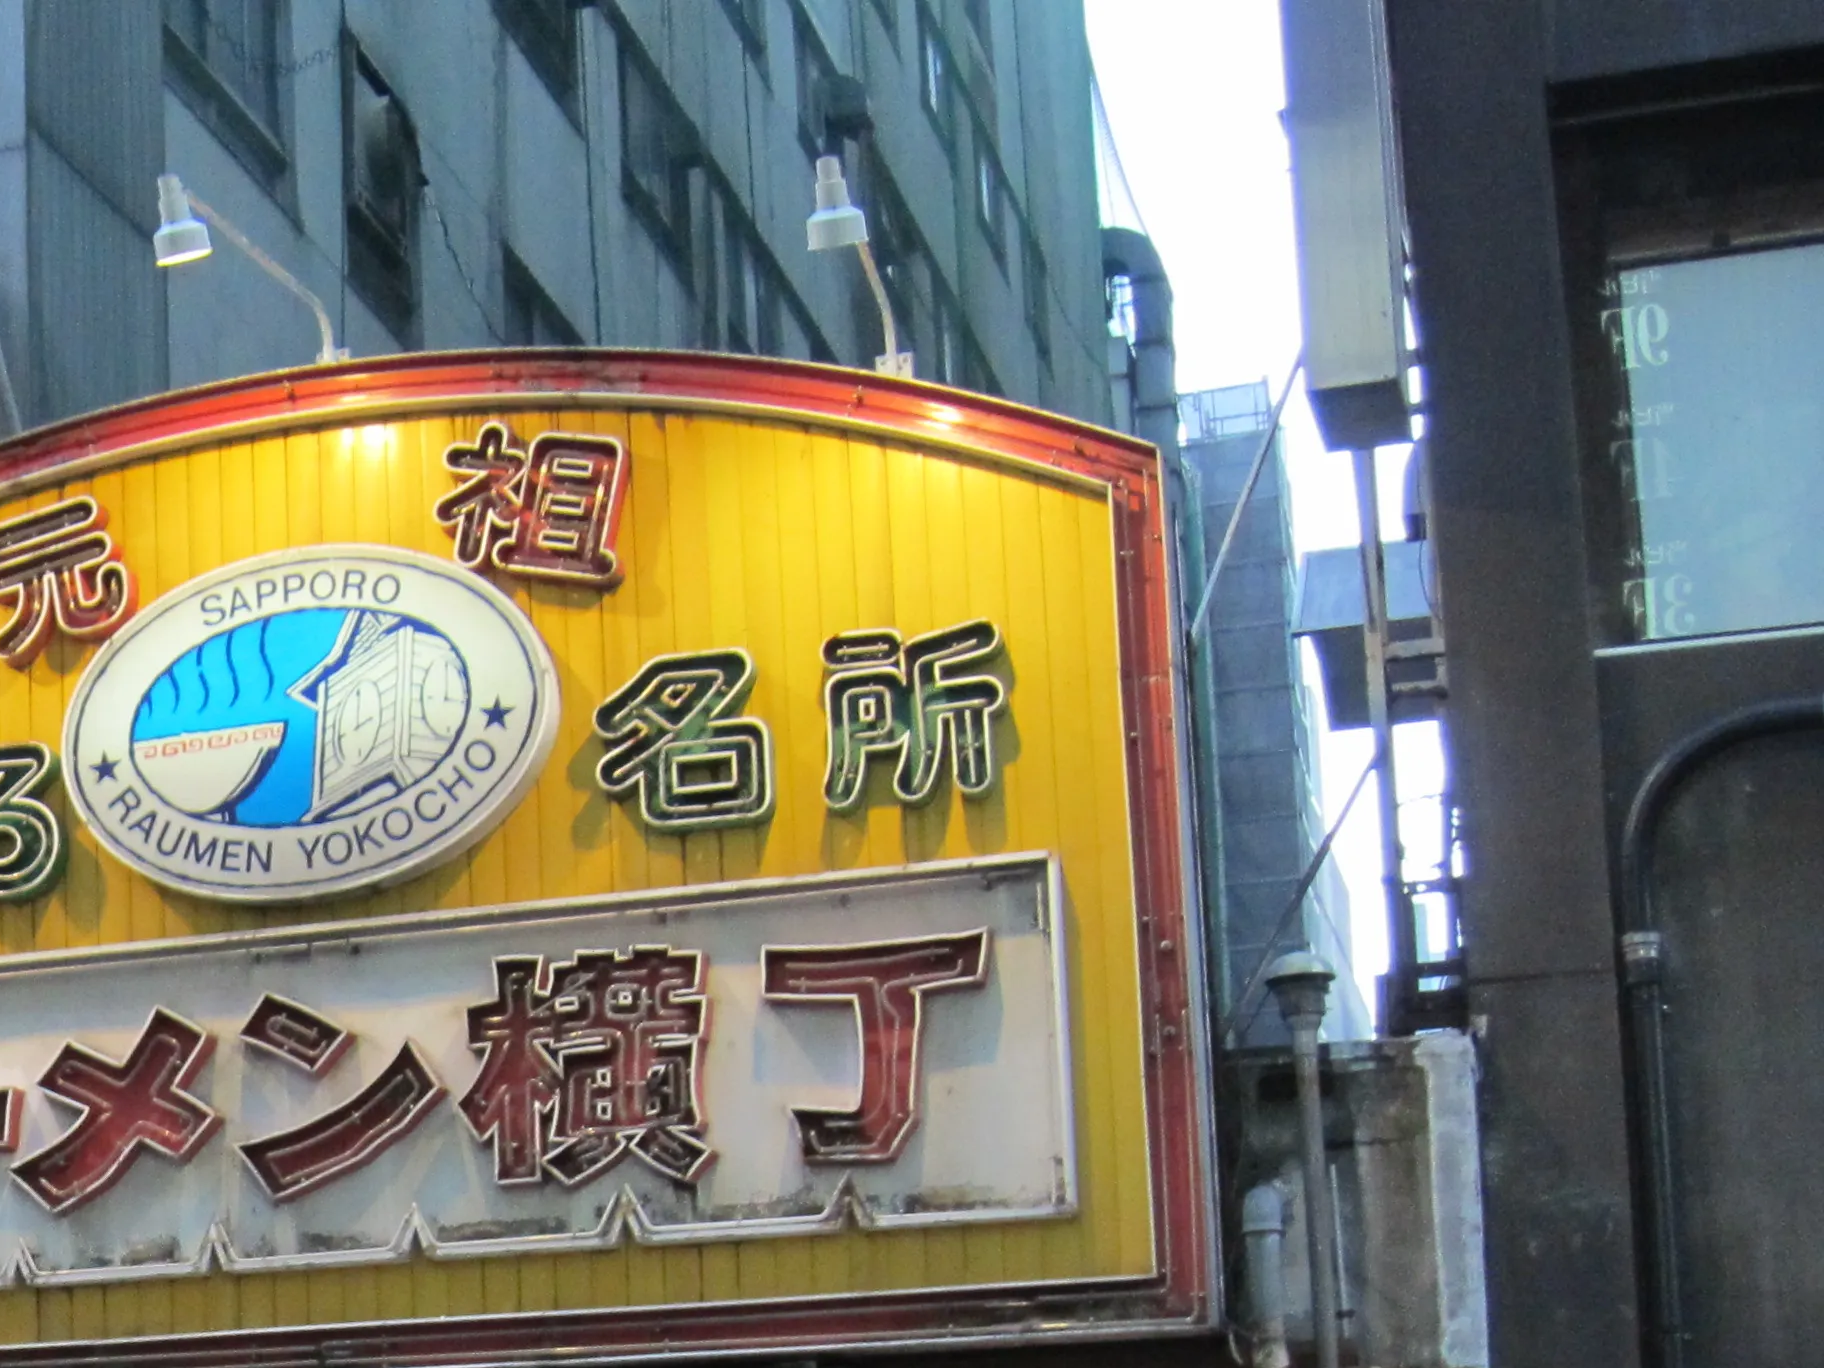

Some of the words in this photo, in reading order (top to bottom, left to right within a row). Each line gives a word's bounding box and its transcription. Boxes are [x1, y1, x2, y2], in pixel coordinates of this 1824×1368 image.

[199, 569, 402, 628] SAPPORO
[593, 617, 1012, 834] 名所
[108, 784, 274, 875] RAUMEN
[297, 738, 498, 871] YOKOCHO
